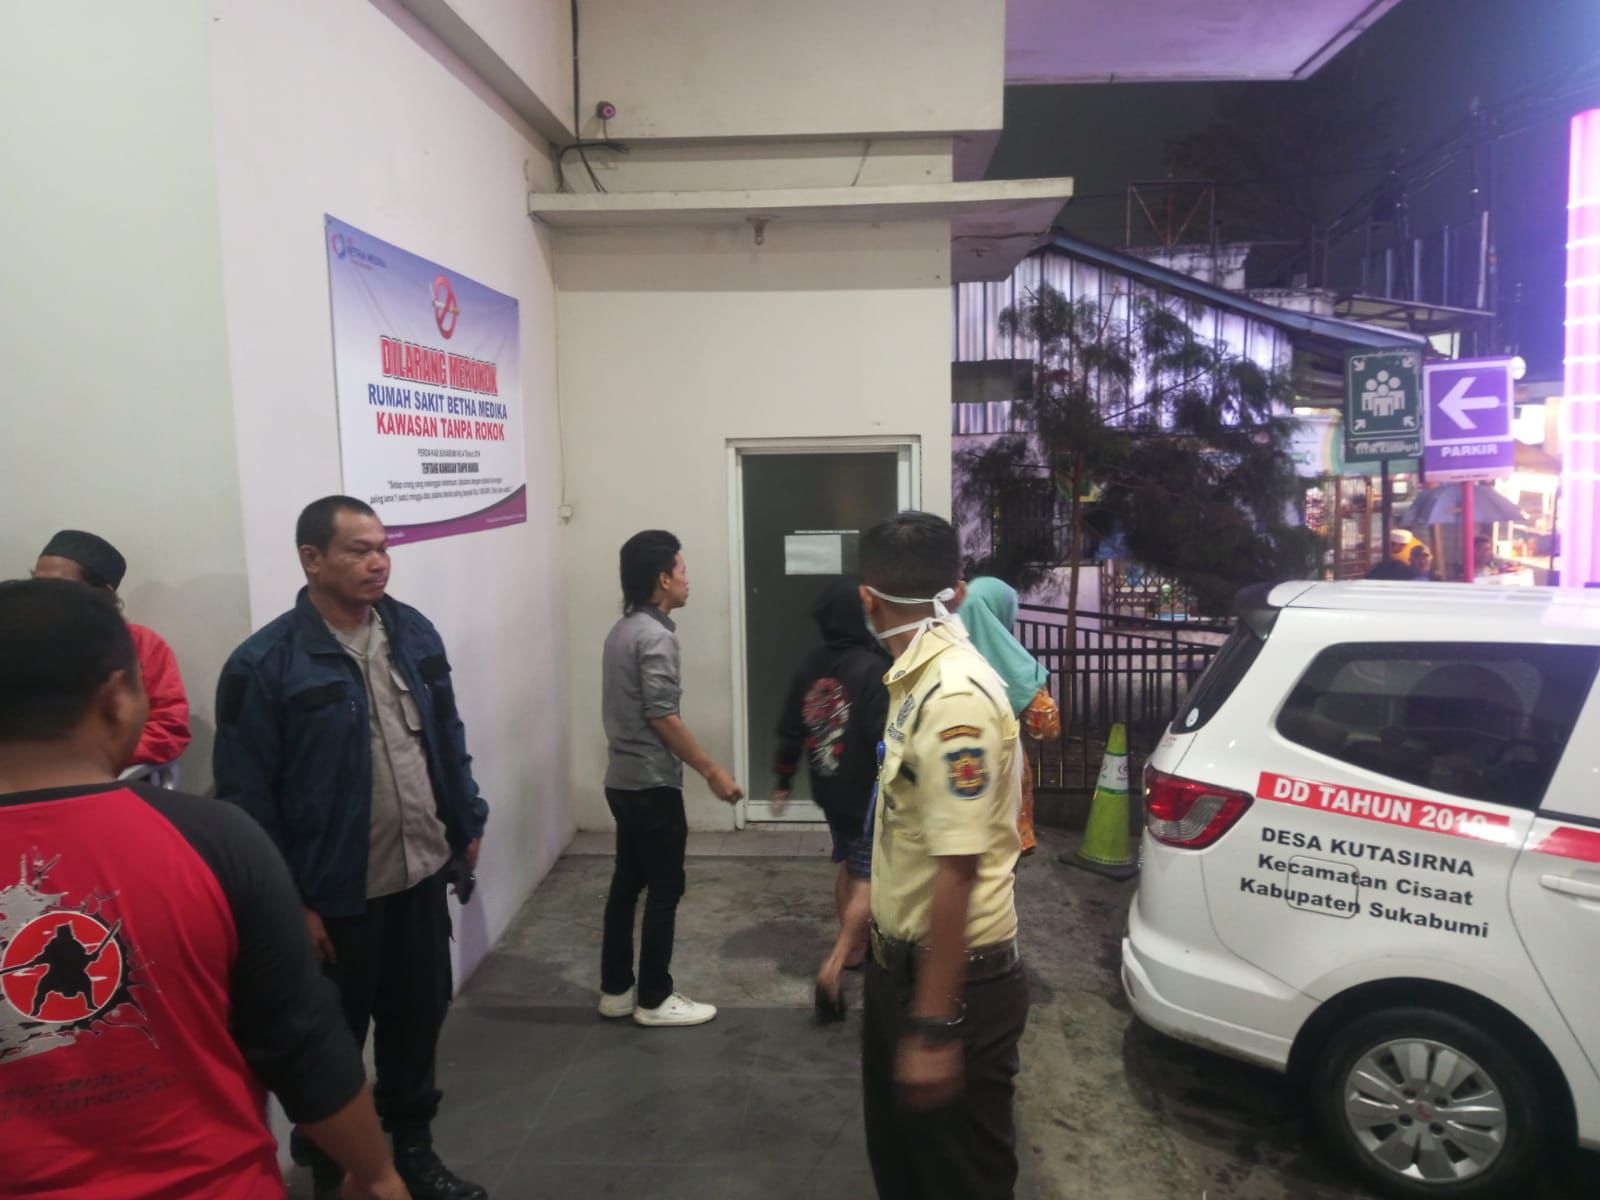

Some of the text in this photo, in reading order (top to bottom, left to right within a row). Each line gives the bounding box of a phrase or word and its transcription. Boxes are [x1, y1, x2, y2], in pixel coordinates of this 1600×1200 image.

[380, 335, 498, 396] DILARANG MEROKOK
[368, 383, 508, 419] RUMAH SAKIT BETHA MEDIKA
[376, 411, 505, 441] KAWASAN TANPA ROKOK
[1440, 443, 1498, 458] PARKIR
[1273, 777, 1310, 803] DD
[1318, 785, 1412, 824] TAHUN
[1261, 827, 1474, 877] DESA KUTASIRNA
[1258, 853, 1473, 906] Kecamatan Cisaat
[1240, 877, 1489, 938] Kabupaten Sukabumi
